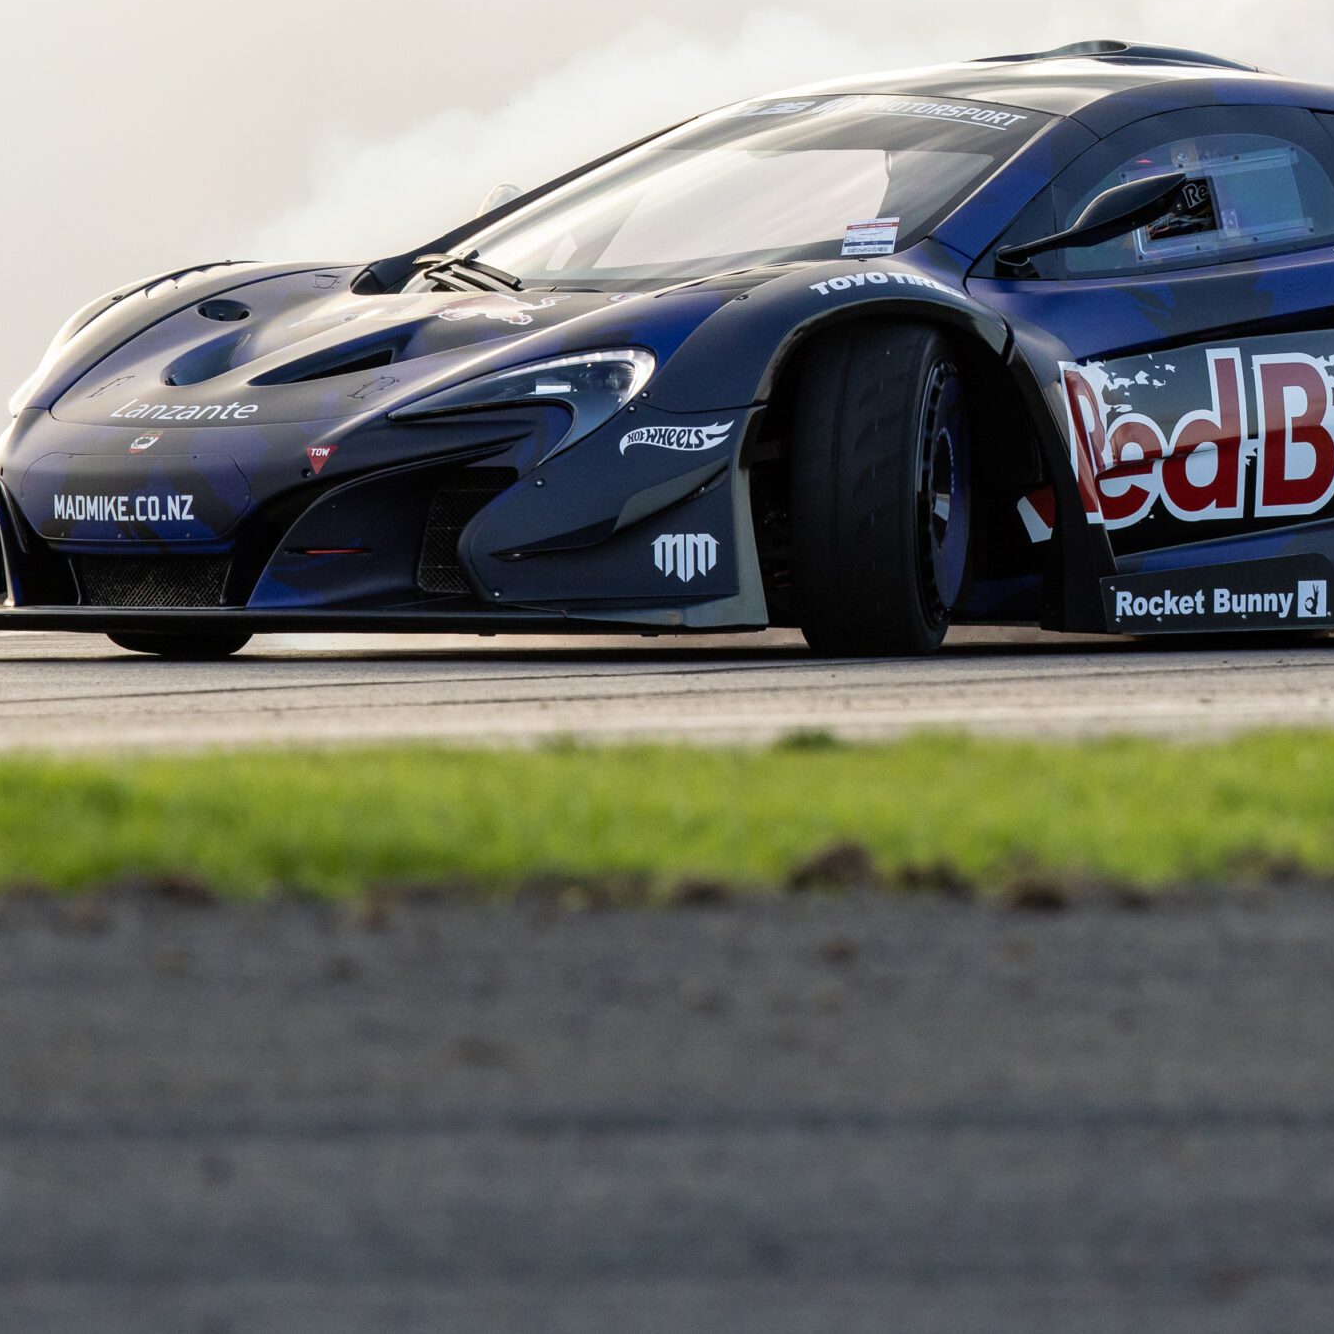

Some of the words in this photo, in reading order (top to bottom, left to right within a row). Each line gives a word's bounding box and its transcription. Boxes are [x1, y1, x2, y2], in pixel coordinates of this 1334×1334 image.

[1181, 183, 1209, 209] Re
[809, 272, 888, 296] TOYO
[109, 398, 259, 421] Lanzante
[1058, 346, 1245, 530] Red
[310, 447, 331, 457] TOW
[53, 494, 195, 522] MADMIKE.CO.NZ
[1116, 589, 1205, 616] Rocket
[1213, 588, 1294, 618] Bunny
